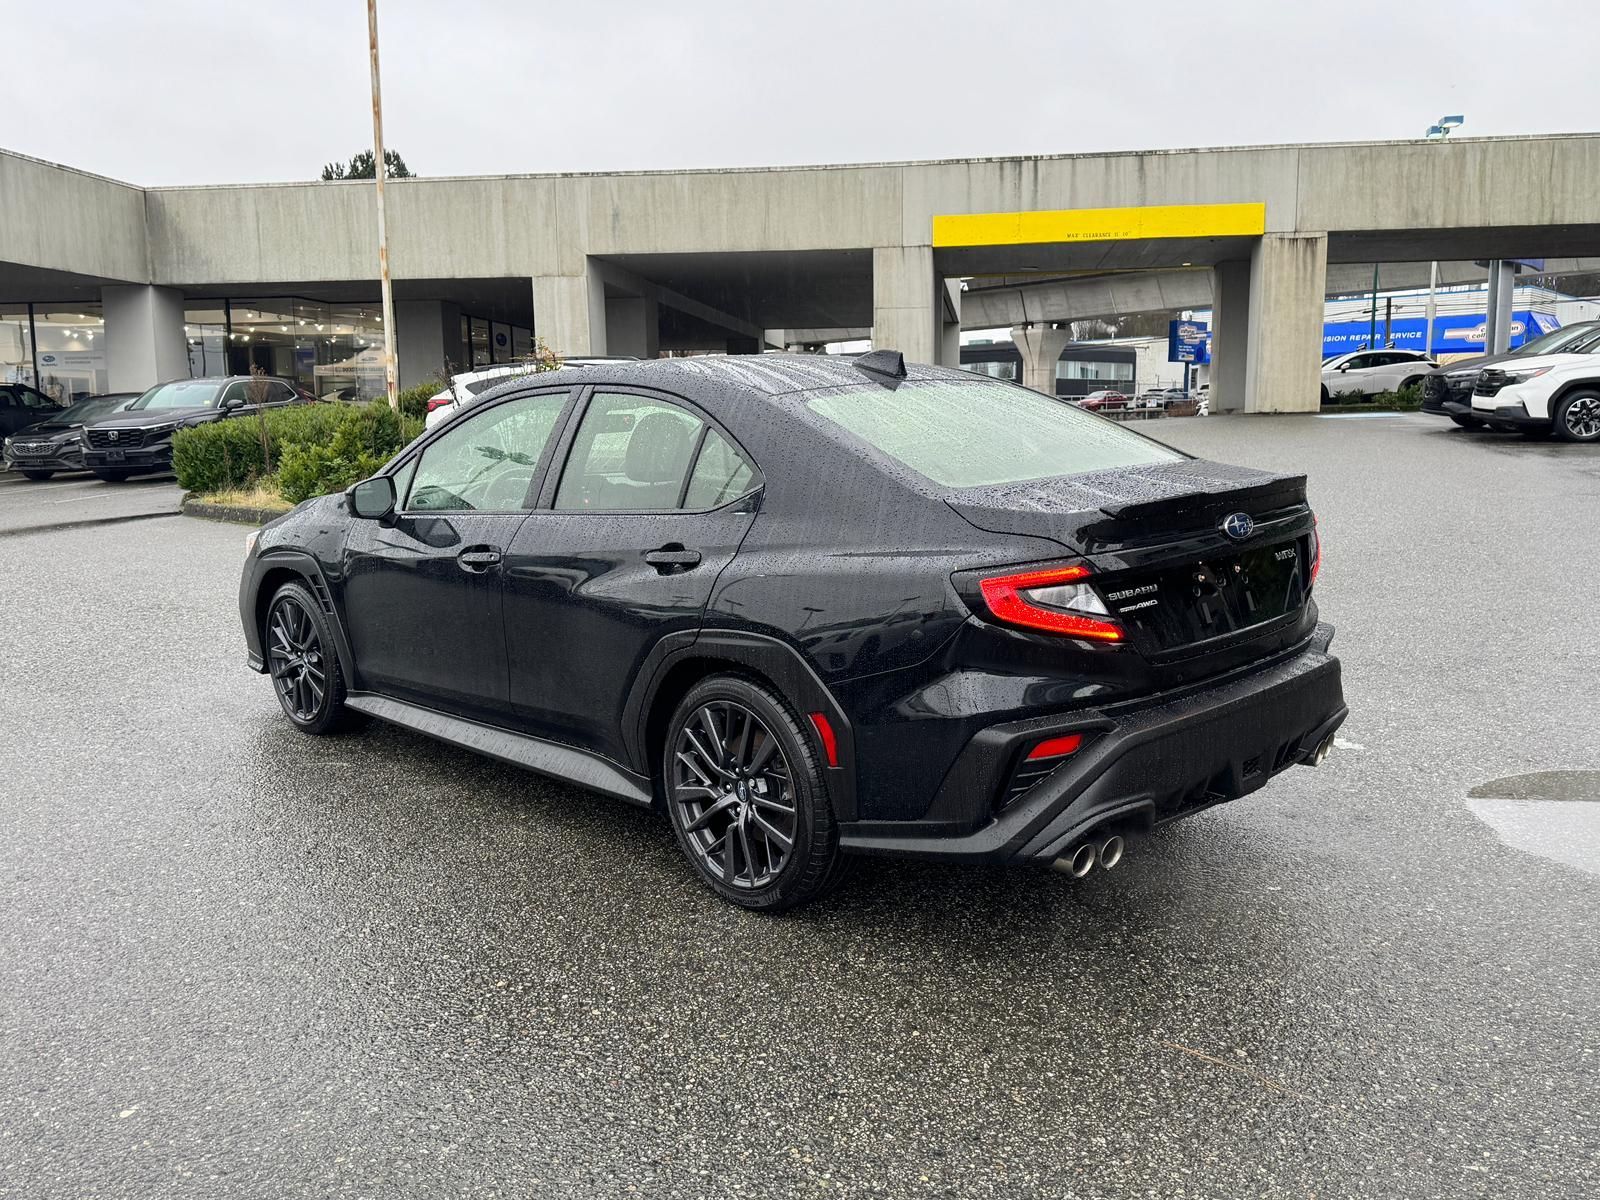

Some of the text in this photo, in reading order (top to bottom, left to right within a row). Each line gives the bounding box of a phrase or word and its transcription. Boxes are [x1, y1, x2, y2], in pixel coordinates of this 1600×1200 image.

[1349, 333, 1380, 341] REPAR
[1384, 331, 1422, 339] ERVICE
[1274, 548, 1297, 561] WRX
[1108, 583, 1158, 601] SUBARU
